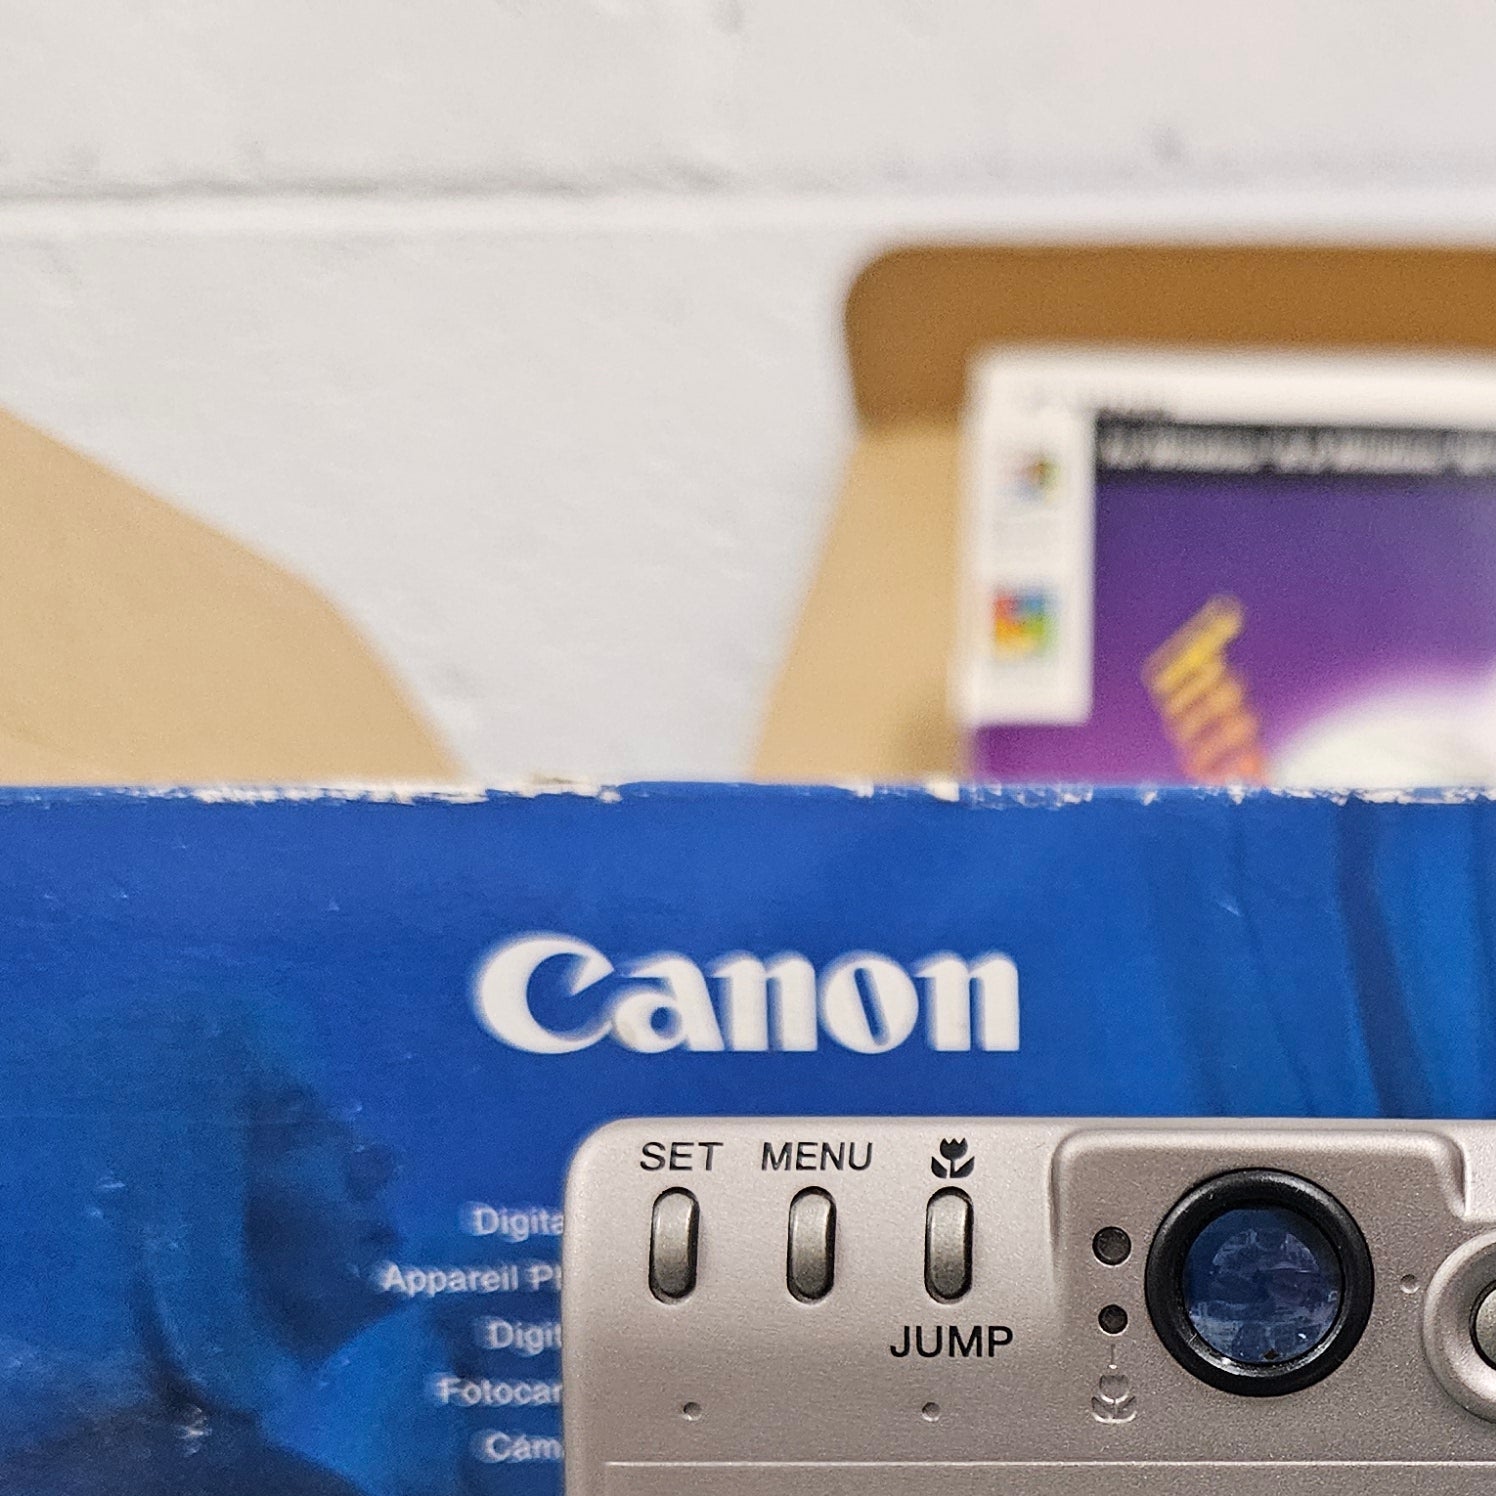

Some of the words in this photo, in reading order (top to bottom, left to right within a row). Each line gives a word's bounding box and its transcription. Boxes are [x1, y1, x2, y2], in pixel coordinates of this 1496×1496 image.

[474, 931, 1020, 1054] Canon
[640, 1141, 723, 1171] SET
[761, 1141, 873, 1171] MENU
[378, 1261, 519, 1297] Appareil
[890, 1325, 1014, 1358] JUMP
